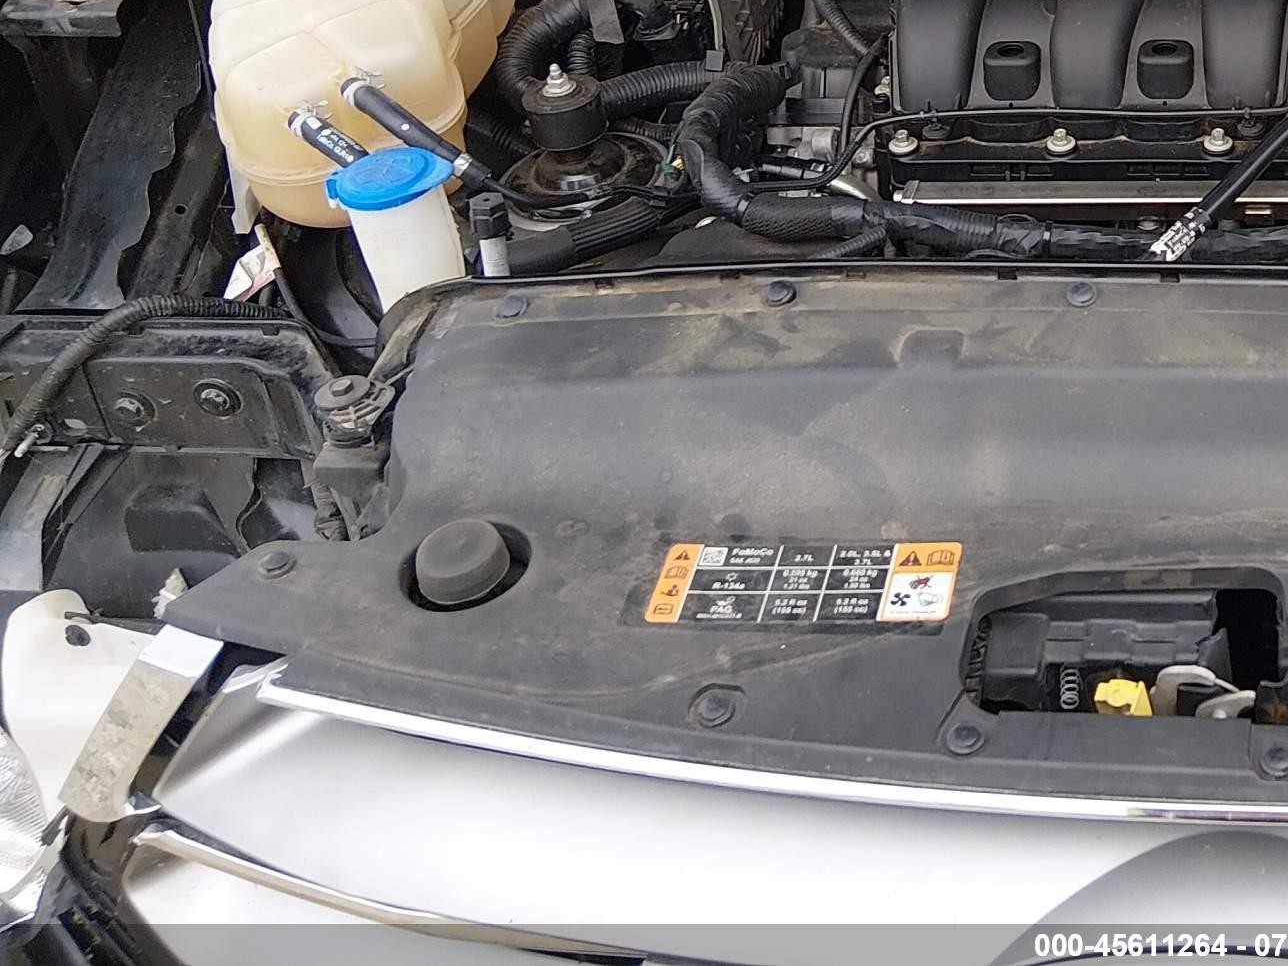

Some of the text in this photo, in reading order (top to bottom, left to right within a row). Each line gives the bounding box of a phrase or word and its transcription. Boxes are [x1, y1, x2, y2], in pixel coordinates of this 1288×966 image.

[731, 547, 774, 556] FoMoCo
[794, 554, 814, 562] 2.7L
[710, 605, 733, 613] PAG
